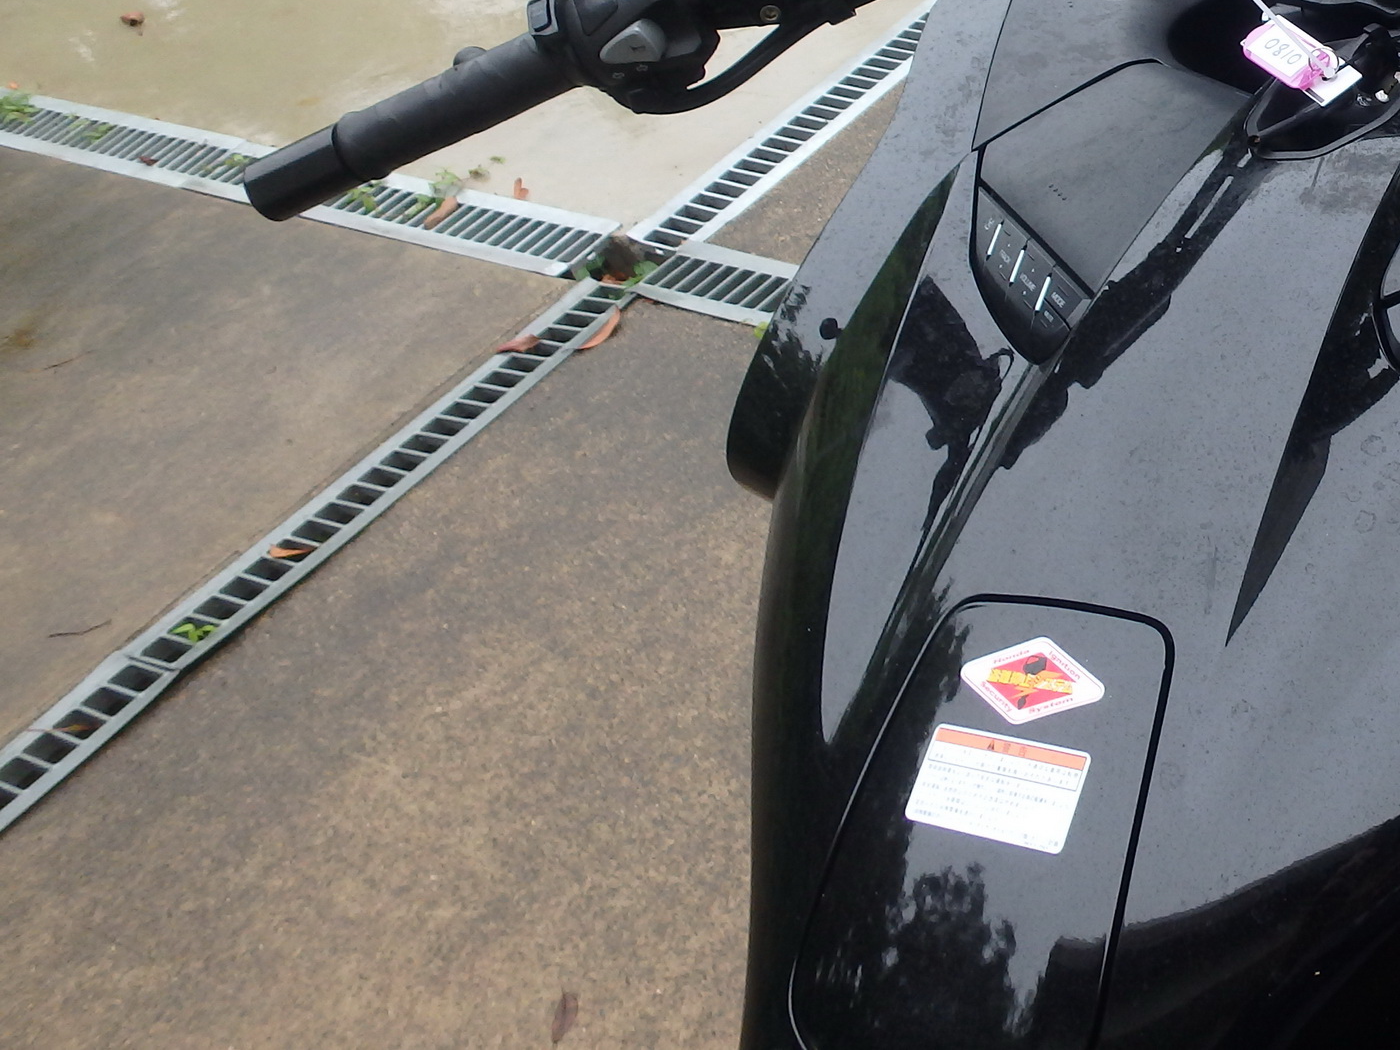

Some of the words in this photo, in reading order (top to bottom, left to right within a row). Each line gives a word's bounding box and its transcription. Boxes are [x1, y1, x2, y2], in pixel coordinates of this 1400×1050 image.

[1051, 292, 1066, 309] MODE
[1048, 650, 1082, 681] Ignition
[980, 681, 1013, 713] Security
